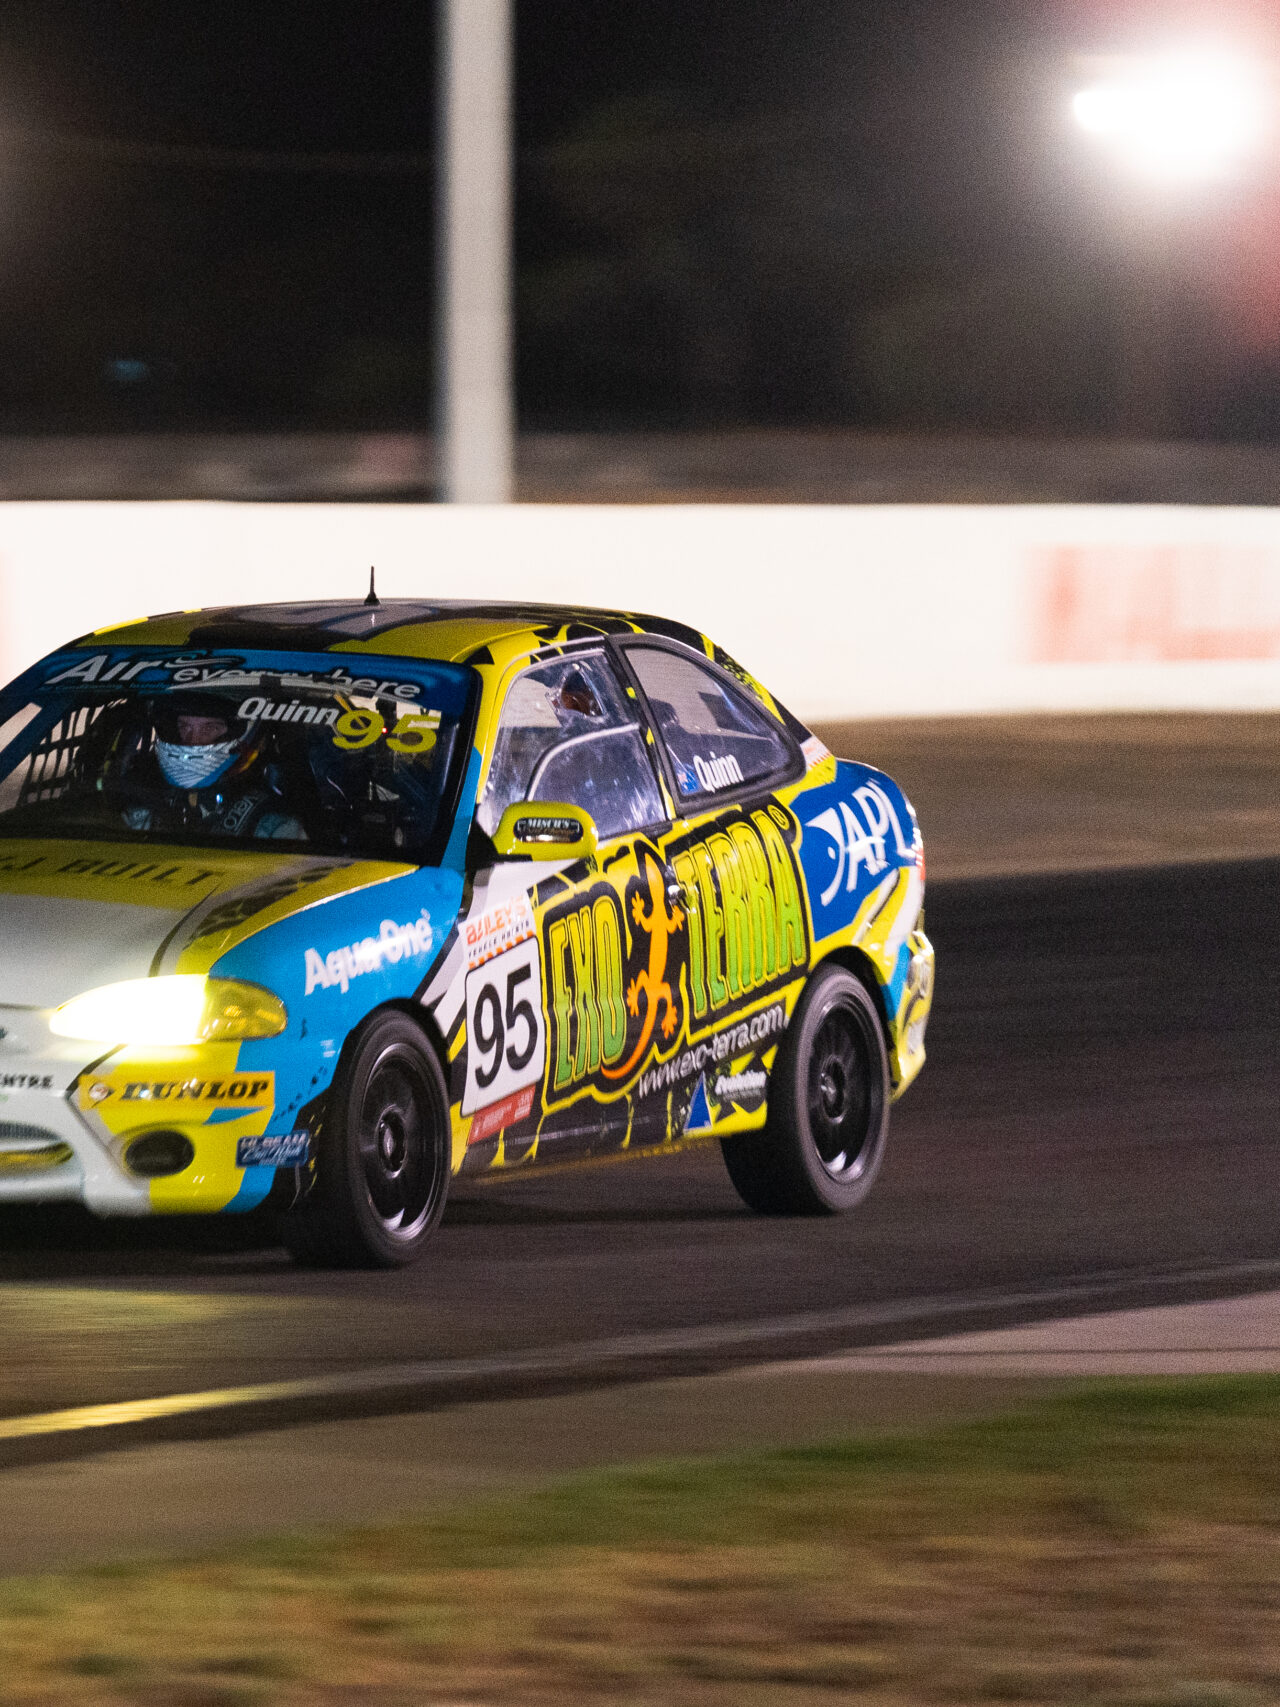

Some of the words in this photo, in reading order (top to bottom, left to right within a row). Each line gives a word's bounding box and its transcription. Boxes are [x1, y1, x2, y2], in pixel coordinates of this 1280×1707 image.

[237, 697, 340, 725] Quinn
[333, 709, 442, 753] 95
[693, 751, 744, 793] Quinn
[57, 859, 223, 886] BUILT
[549, 896, 626, 1091] EXO
[671, 810, 807, 1019] TERRA
[473, 962, 539, 1089] 95
[120, 1079, 270, 1101] DUNLOP
